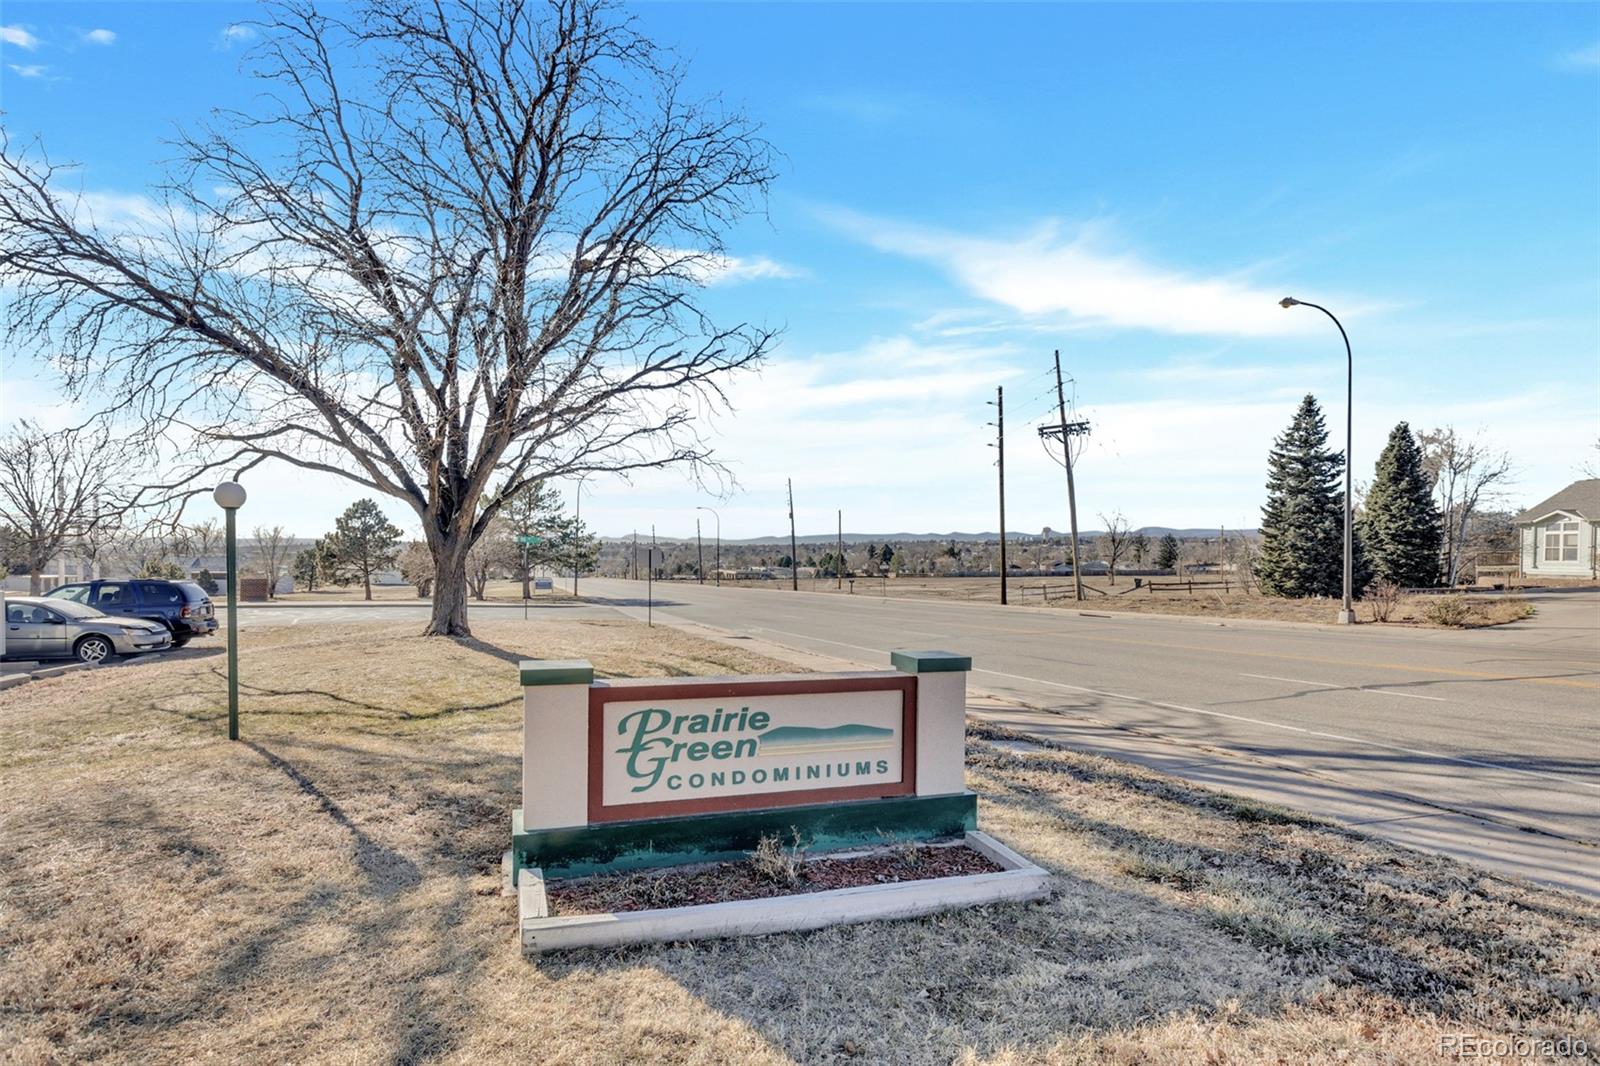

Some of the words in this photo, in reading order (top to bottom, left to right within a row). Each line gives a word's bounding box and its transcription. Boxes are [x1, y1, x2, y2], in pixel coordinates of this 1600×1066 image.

[616, 707, 771, 753] Prairie
[626, 736, 758, 793] Green
[666, 759, 889, 790] CONDOMINIUMS
